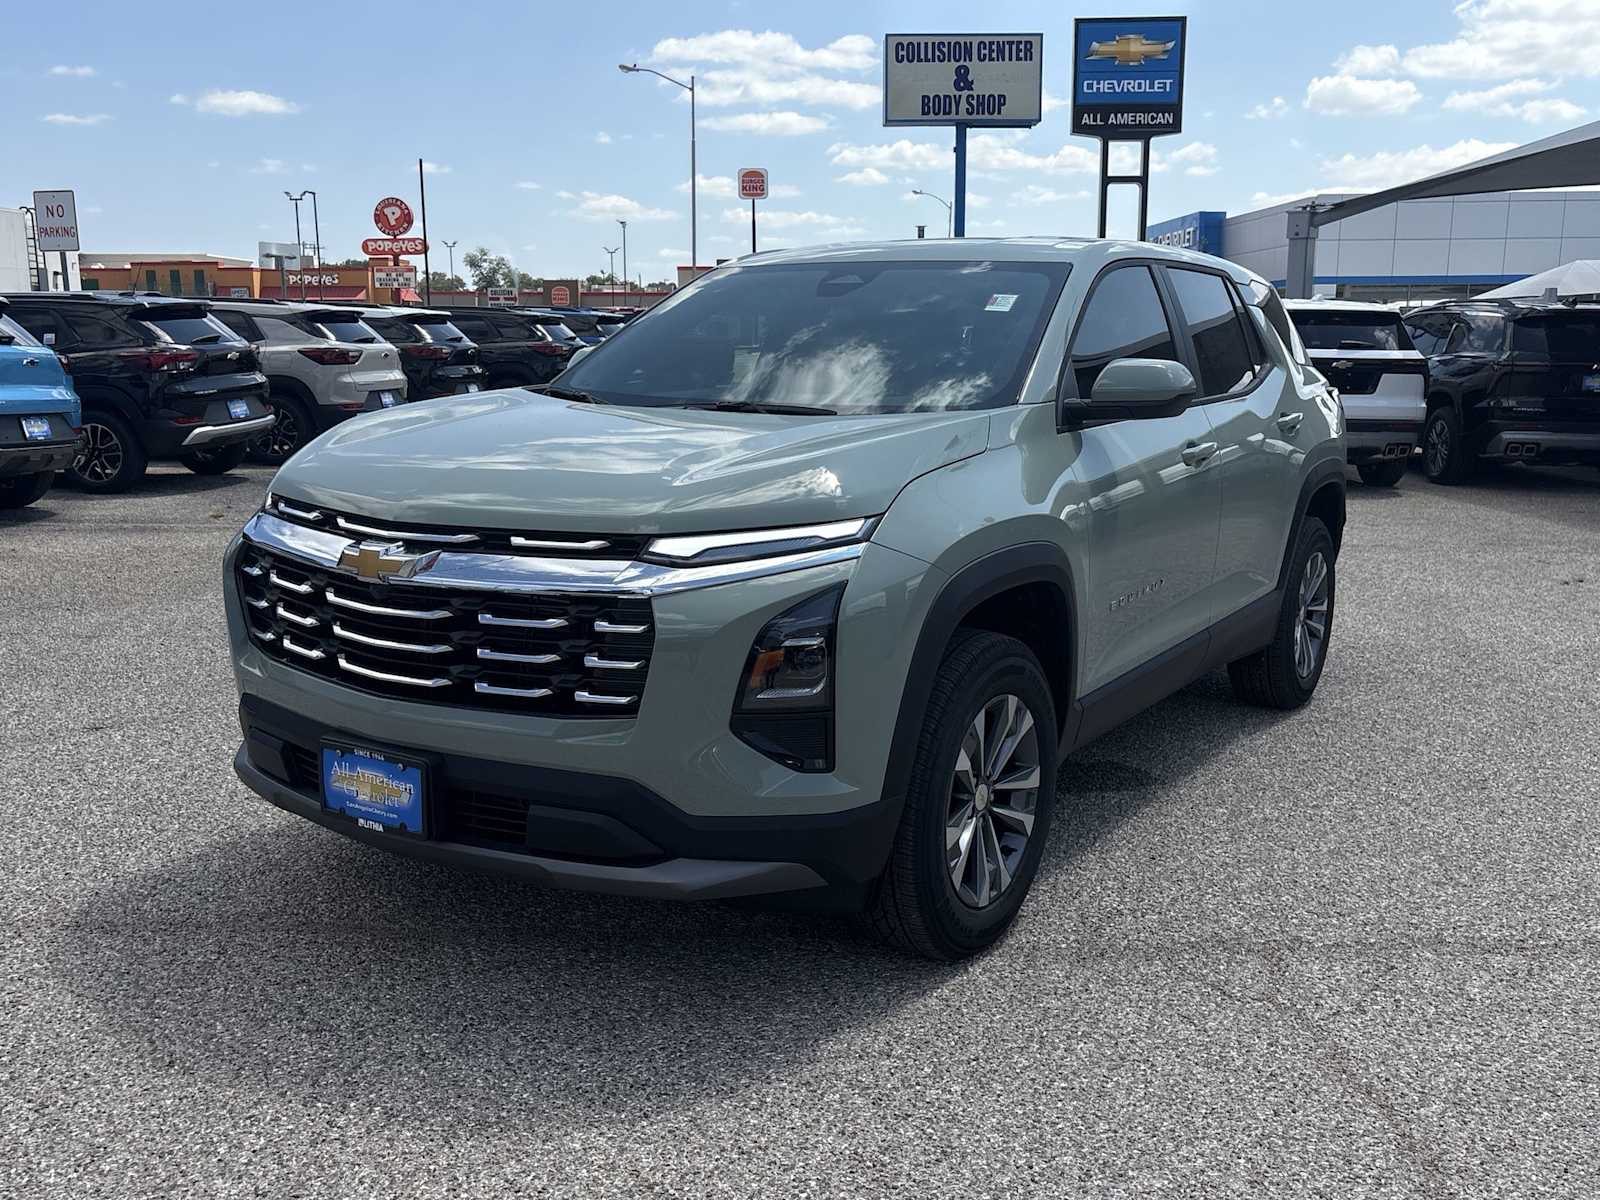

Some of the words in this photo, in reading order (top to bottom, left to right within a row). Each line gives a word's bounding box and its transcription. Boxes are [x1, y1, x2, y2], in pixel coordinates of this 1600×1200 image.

[895, 41, 973, 63] COLLISION
[977, 40, 1034, 62] CENTER
[953, 64, 974, 92] &
[1083, 79, 1173, 93] CHEVROLET
[921, 94, 962, 116] BODY
[965, 93, 1007, 116] SHOP
[1081, 113, 1104, 125] ALL
[1108, 112, 1174, 125] AMERICAN
[741, 184, 765, 192] KING
[46, 204, 65, 218] NO
[39, 226, 76, 239] PARKING
[331, 761, 350, 778] All
[353, 767, 414, 794] American
